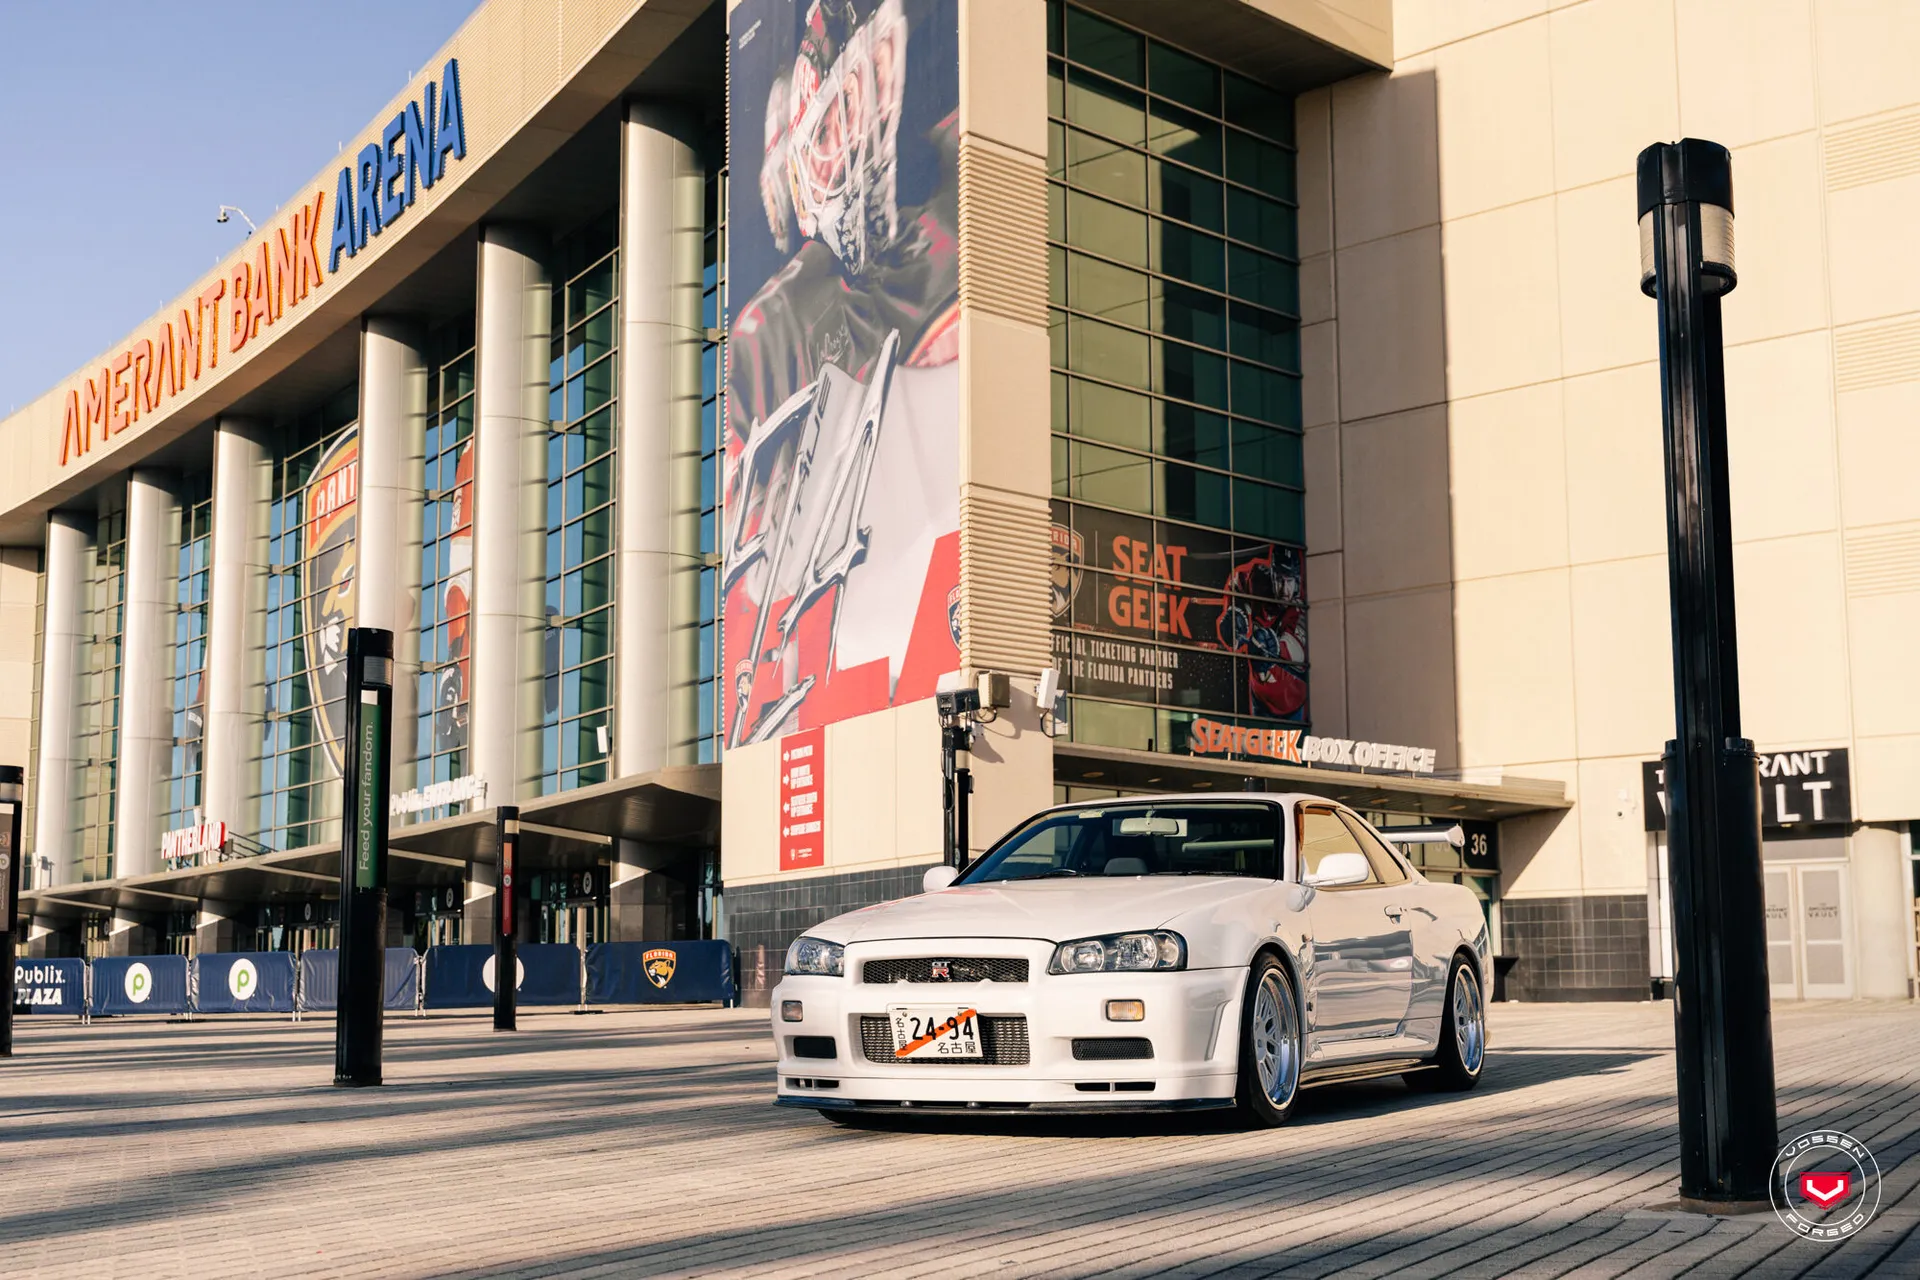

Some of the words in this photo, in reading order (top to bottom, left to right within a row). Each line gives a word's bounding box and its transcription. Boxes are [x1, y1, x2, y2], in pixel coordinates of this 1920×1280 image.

[59, 279, 226, 466] AMERANT
[229, 191, 325, 353] BANK
[328, 58, 467, 274] ARENA
[315, 461, 357, 535] PANT
[1053, 530, 1078, 550] RIDA
[1112, 535, 1188, 591] SEAT
[1108, 585, 1192, 639] GEEK
[1051, 633, 1087, 656] FFICAL
[1091, 640, 1137, 663] TICKETING
[1139, 647, 1179, 669] PARTNER
[1088, 661, 1125, 684] FLORIDA
[1128, 667, 1173, 690] PANTHERS
[361, 721, 374, 790] fandom.
[1191, 718, 1303, 764] SEATGEEK
[1302, 735, 1355, 765] BOX
[1354, 741, 1437, 773] OFFICE
[1758, 750, 1831, 778] RANT
[362, 793, 374, 827] your
[161, 822, 225, 860] PANTHERLAND
[359, 830, 370, 871] Feed
[1471, 833, 1488, 856] 36
[645, 951, 674, 959] FLORIDA
[15, 988, 63, 1005] PLAZA
[910, 1016, 974, 1041] 24-94
[937, 1041, 977, 1054] 名古屋
